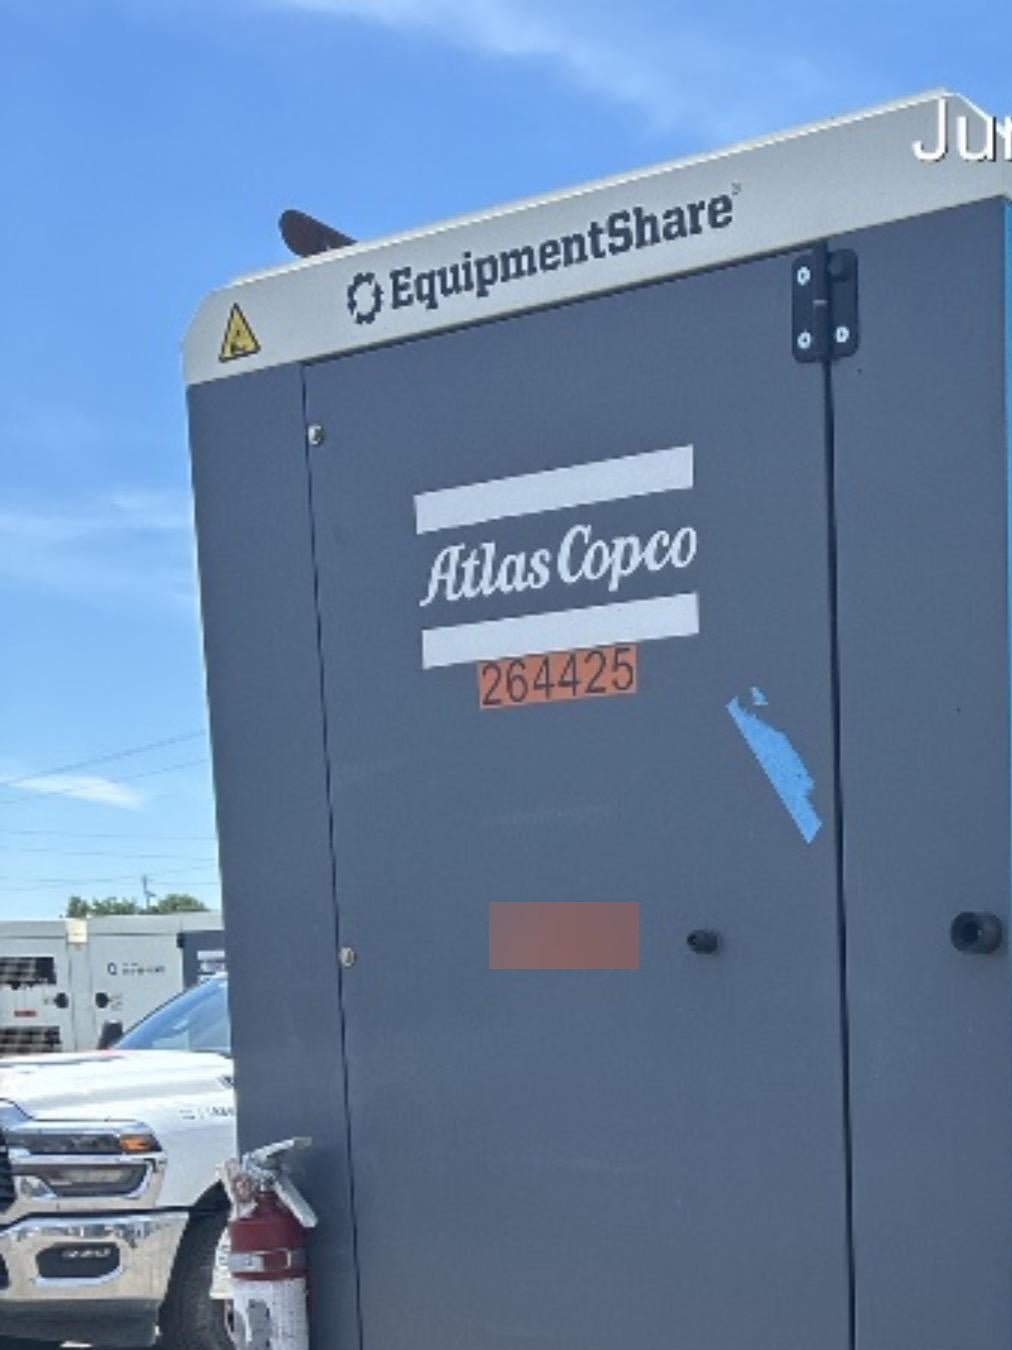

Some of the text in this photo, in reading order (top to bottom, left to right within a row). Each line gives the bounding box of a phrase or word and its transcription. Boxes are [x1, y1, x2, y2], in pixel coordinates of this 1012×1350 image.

[390, 194, 733, 309] EquipmentShare
[420, 524, 697, 607] Atlas Copco
[482, 648, 634, 706] 264425
